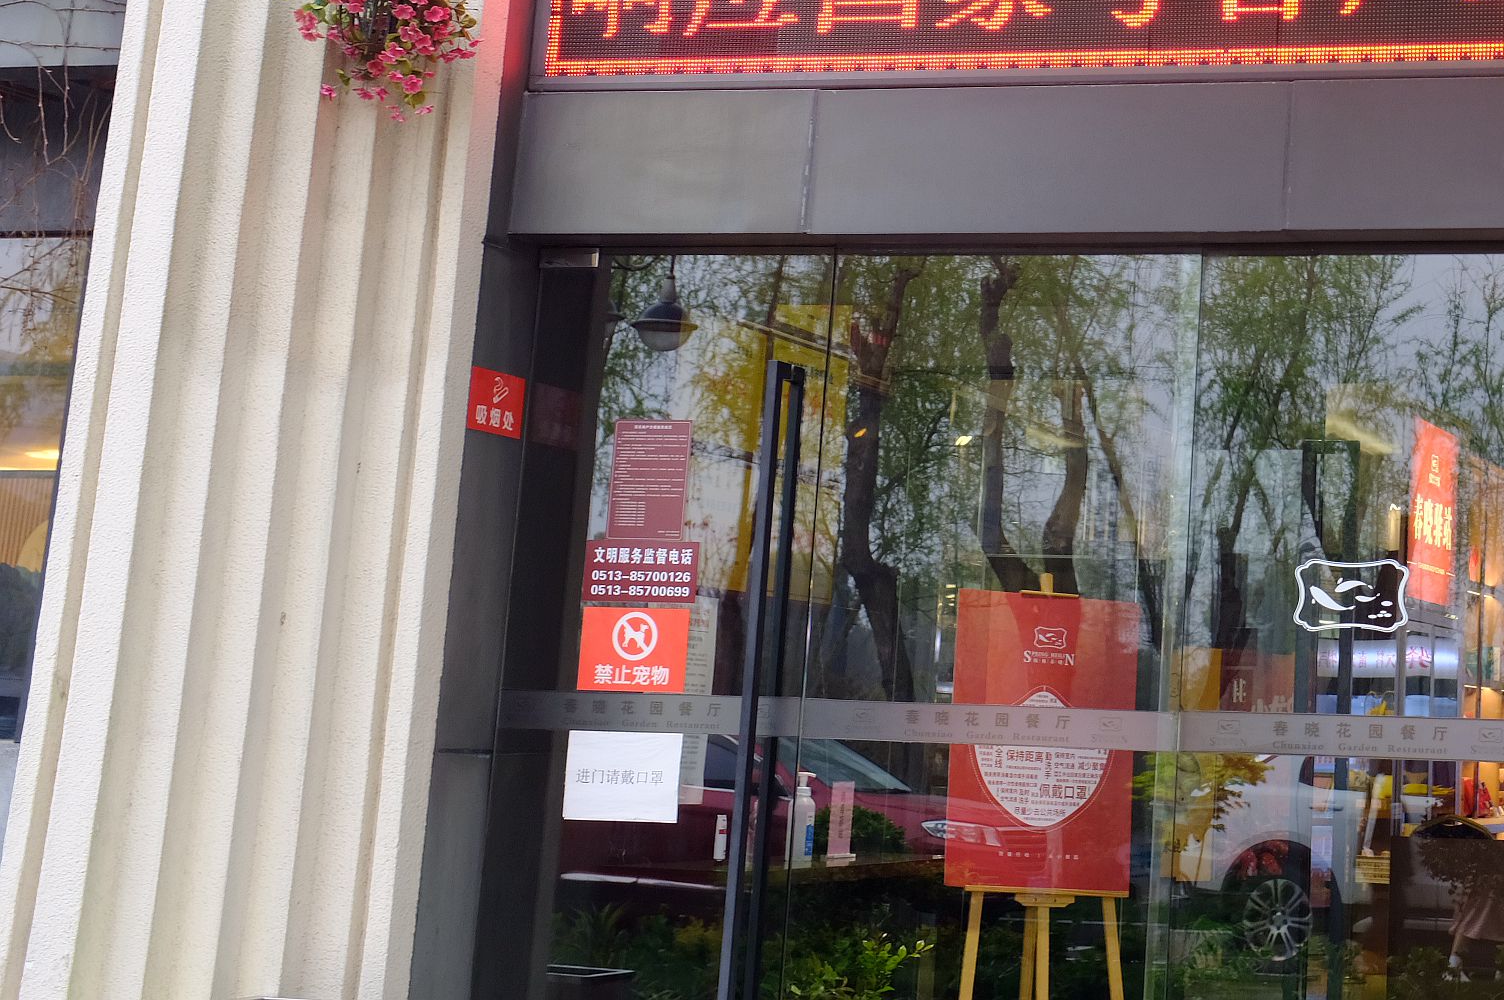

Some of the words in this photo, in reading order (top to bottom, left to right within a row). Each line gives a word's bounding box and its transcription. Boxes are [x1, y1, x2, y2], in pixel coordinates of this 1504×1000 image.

[475, 404, 515, 431] 吸烟处
[1413, 494, 1453, 551] 春晓驿站
[592, 547, 693, 566] 文明服务监督电话
[591, 570, 691, 584] 0513-85700126
[590, 585, 690, 598] 0513-85700699
[594, 664, 671, 686] 禁止宠物
[904, 709, 1072, 730] 春晓花园餐厅
[904, 729, 953, 740] Chunxiao
[966, 731, 1004, 741] Garden
[1012, 732, 1070, 743] Restaurant
[1272, 720, 1448, 740] 春晓花园餐厅
[1006, 749, 1043, 763] 保持距离
[1271, 740, 1324, 751] Chunxiao
[1338, 742, 1377, 752] Garden
[1387, 744, 1448, 755] Restaurant
[575, 768, 665, 786] 进门请戴口罩
[1039, 783, 1088, 800] 佩戴口罩
